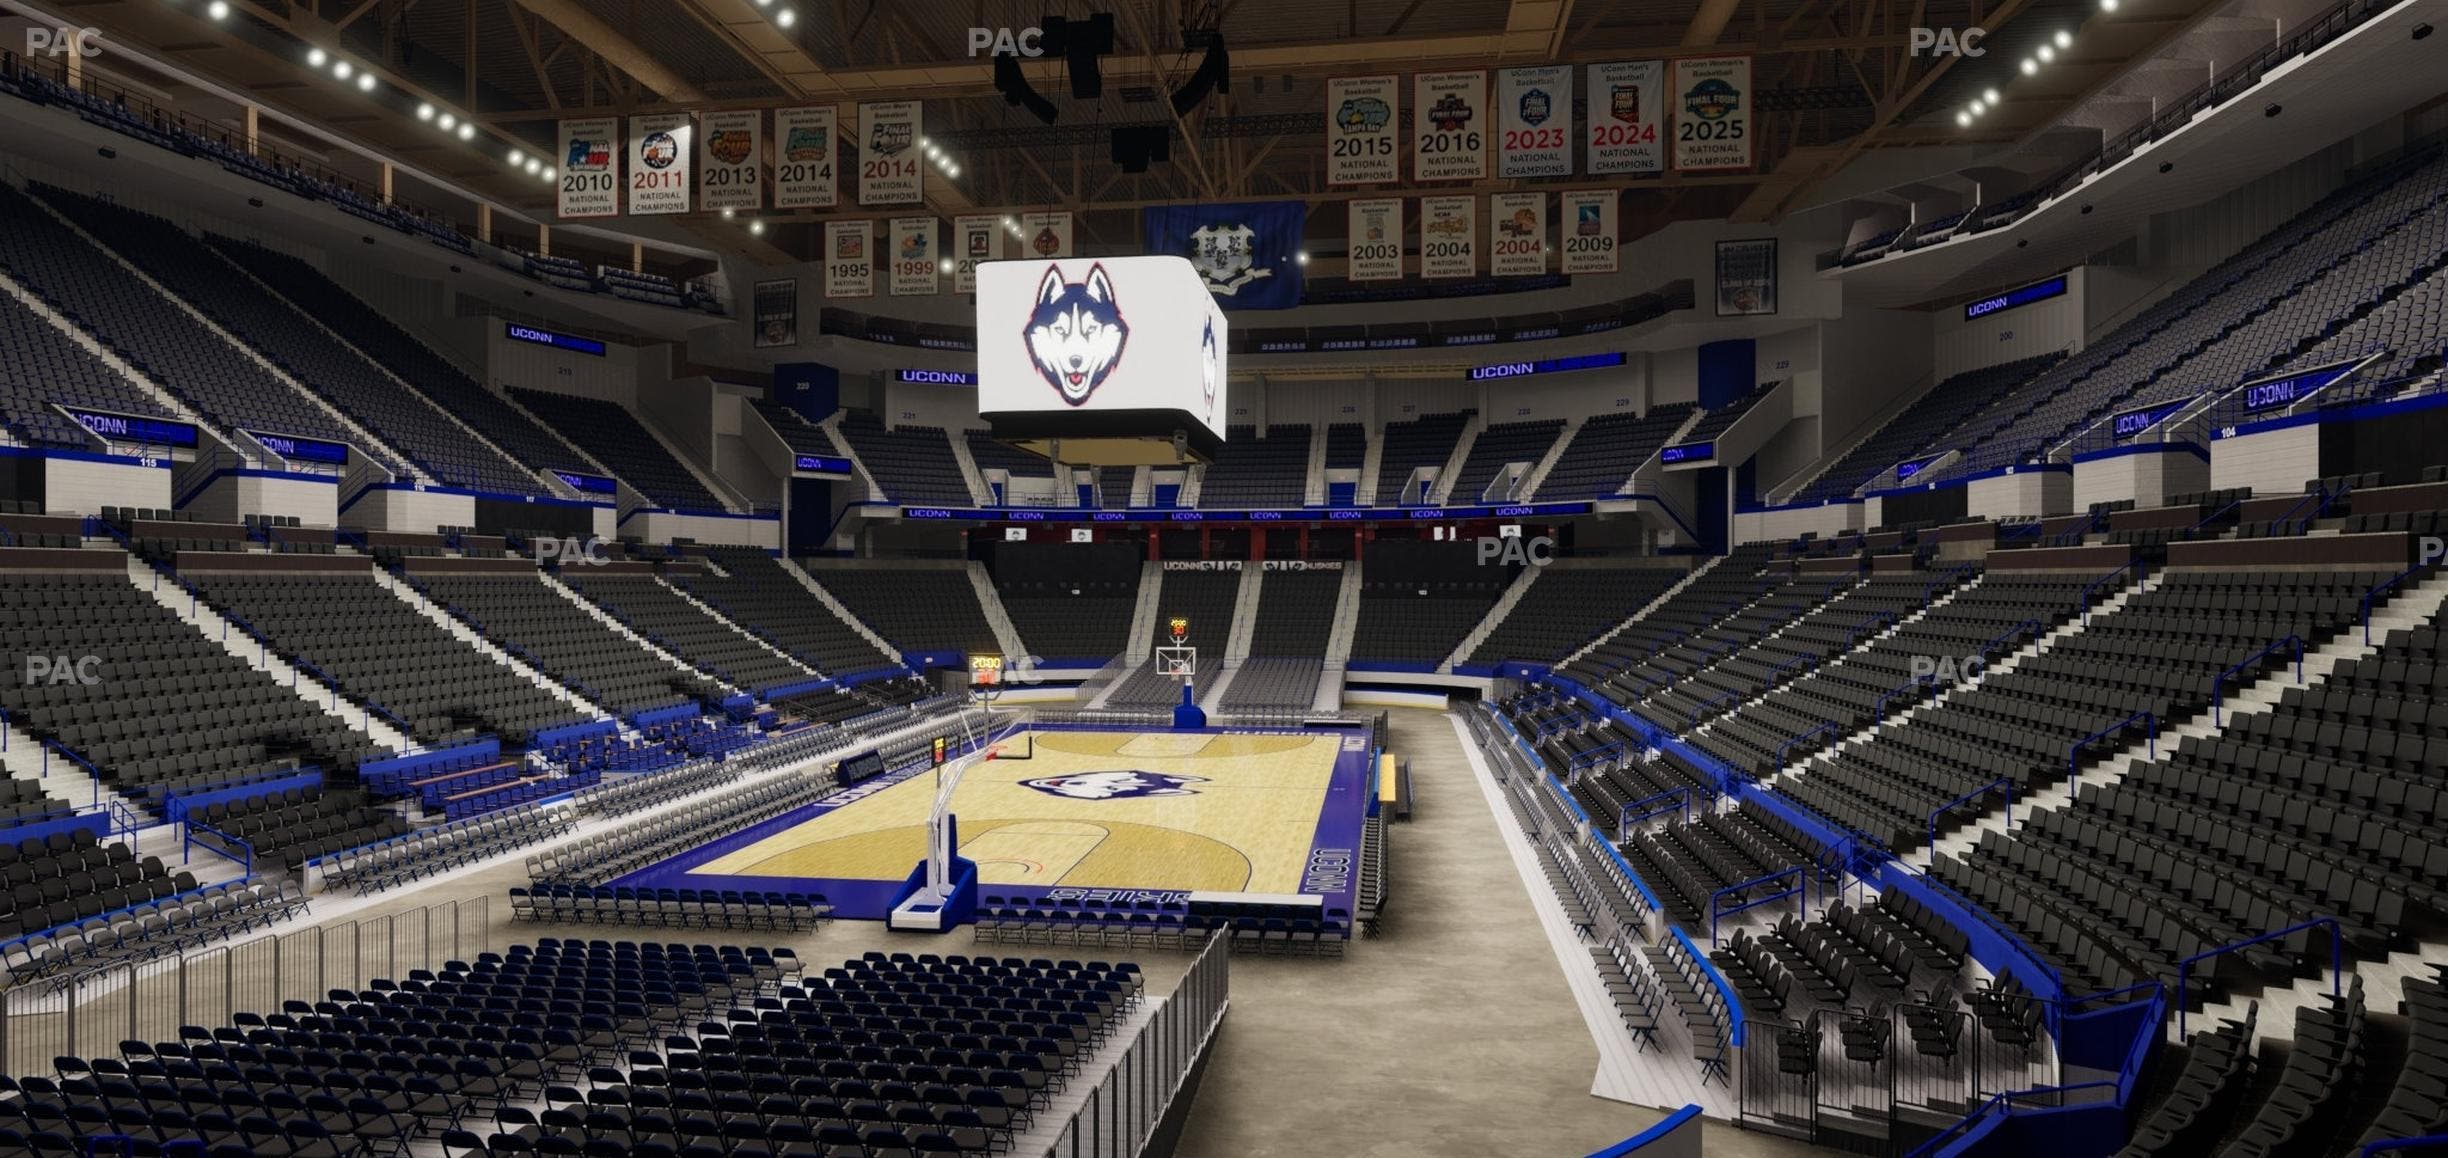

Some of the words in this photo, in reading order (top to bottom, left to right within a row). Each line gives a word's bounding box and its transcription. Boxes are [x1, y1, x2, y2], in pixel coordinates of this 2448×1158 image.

[1516, 78, 1554, 86] Basketball
[1606, 74, 1644, 82] Basketball
[1593, 124, 1656, 146] 2024
[1680, 120, 1744, 141] 2025
[1420, 132, 1480, 153] 2016
[1504, 128, 1565, 150] 2023
[1334, 137, 1392, 156] 2015
[1688, 144, 1740, 154] NATIONAL
[1510, 153, 1560, 163] NATIONAL
[1600, 148, 1650, 158] NATIONAL
[1340, 160, 1388, 168] NATIONAL
[1428, 156, 1476, 165] NATIONAL
[1596, 160, 1654, 170] CHAMPIONS
[1683, 156, 1744, 166] CHAMPIONS
[780, 164, 832, 182] 2014
[864, 160, 916, 178] 2014
[1422, 168, 1480, 178] CHAMPIONS
[1506, 165, 1566, 176] CHAMPIONS
[634, 170, 682, 188] 2011
[705, 166, 756, 186] 2013
[1336, 171, 1392, 181] CHAMPIONS
[564, 174, 612, 192] 2010
[870, 182, 913, 190] NATIONAL
[711, 188, 752, 196] NATIONAL
[865, 192, 917, 200] CHAMPIONS
[706, 200, 756, 208] CHAMPIONS
[782, 196, 832, 205] CHAMPIONS
[565, 206, 612, 214] CHAMPIONS
[636, 203, 684, 211] CHAMPIONS
[1496, 240, 1541, 254] 2004
[1566, 236, 1614, 252] 2009
[1354, 244, 1398, 260] 2003
[1426, 242, 1471, 258] 2004
[830, 264, 869, 278] 1995
[894, 261, 934, 276] 1999
[958, 260, 977, 274] 20
[1968, 297, 2007, 316] UCONN
[511, 326, 552, 343] UCONN
[1472, 362, 1534, 379] UCONN
[903, 370, 966, 383] UCONN
[2248, 380, 2294, 407] UCONN
[2116, 412, 2150, 433] UCONN
[2222, 426, 2236, 438] 104
[258, 436, 294, 454] CONN
[140, 458, 157, 468] 115
[910, 510, 950, 518] UCONN
[1410, 510, 1444, 518] UCONN
[1496, 507, 1533, 516] UCONN
[1164, 561, 1200, 570] UCONN
[1304, 562, 1342, 570] HUSKIES
[972, 658, 1001, 669] 20:00
[1304, 848, 1351, 893] UCONN
